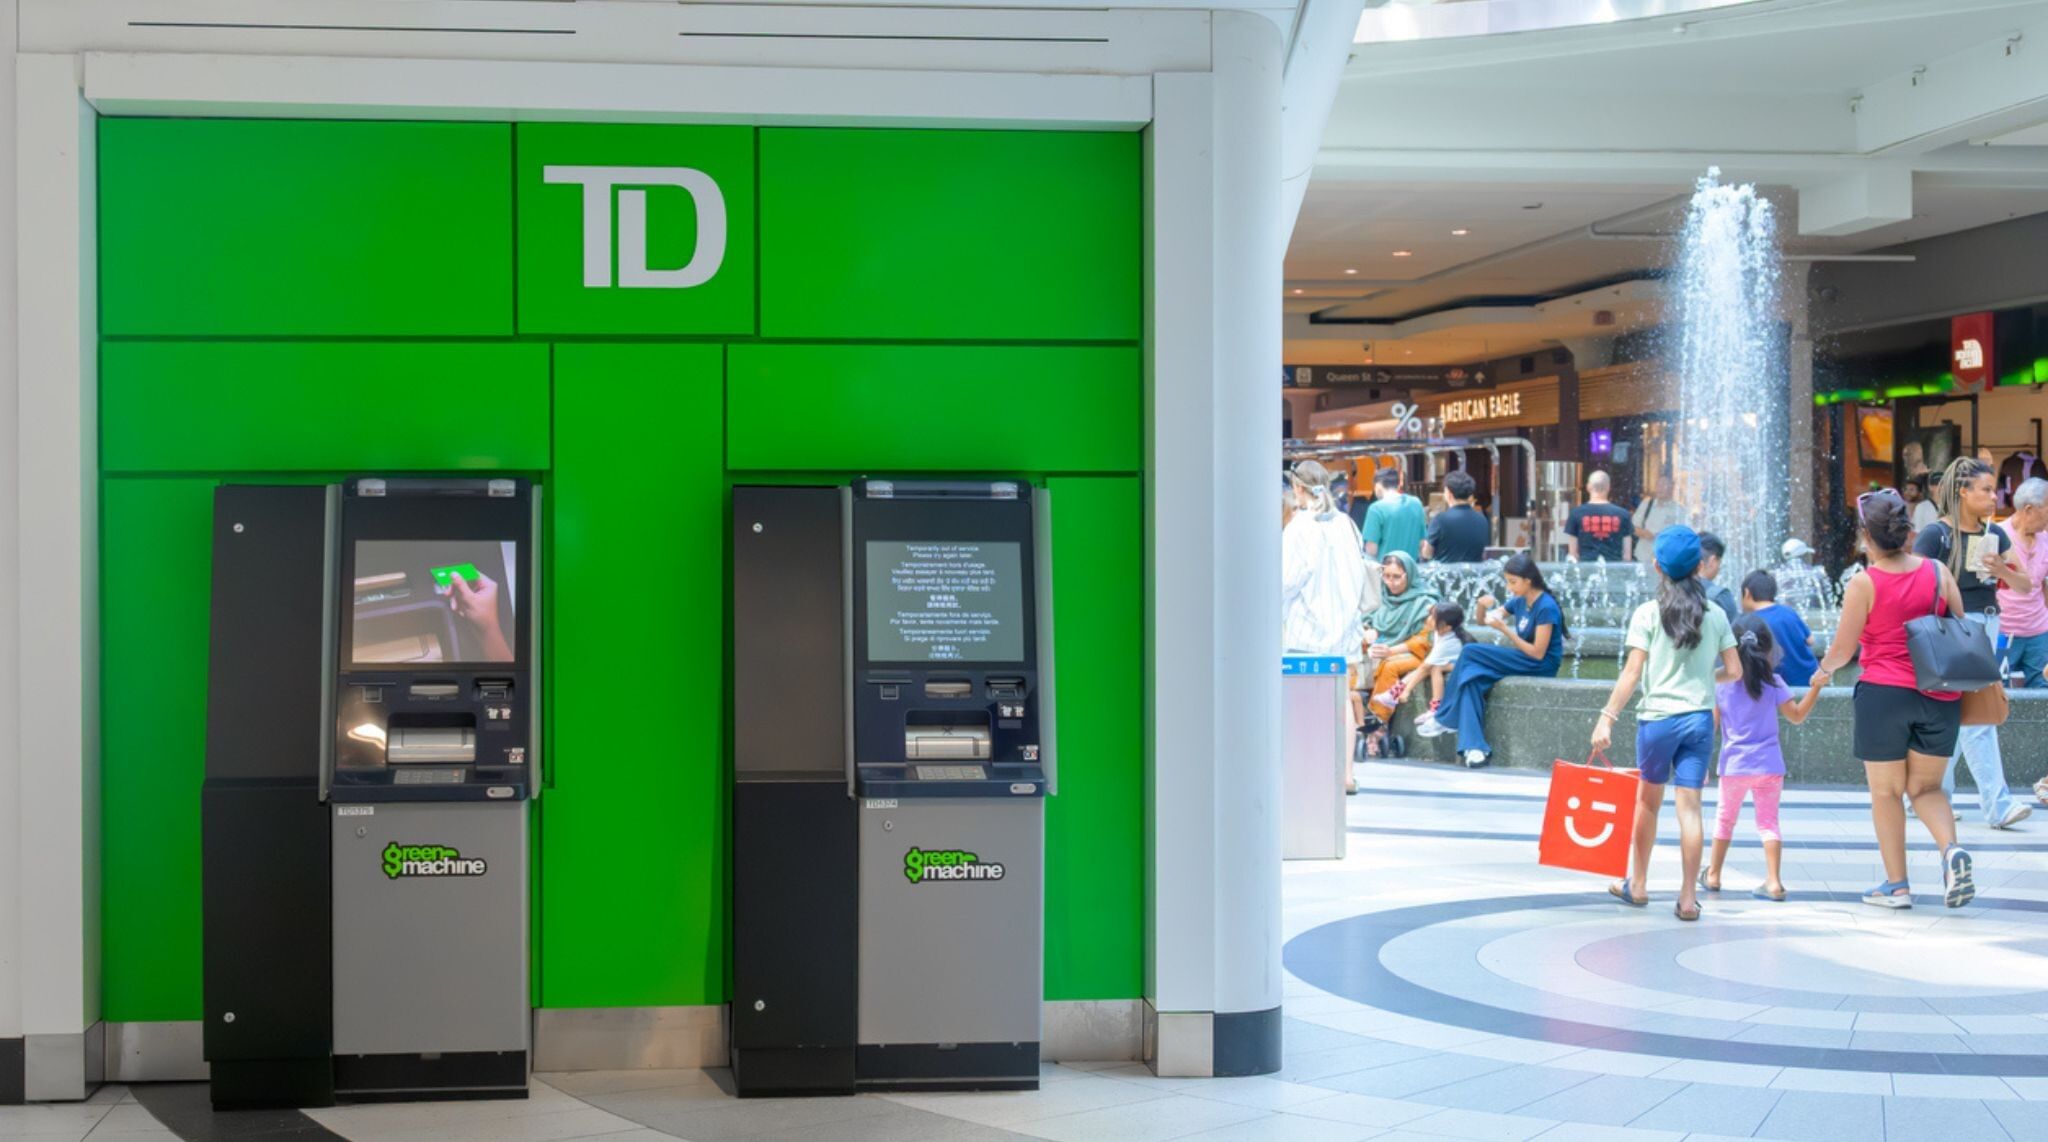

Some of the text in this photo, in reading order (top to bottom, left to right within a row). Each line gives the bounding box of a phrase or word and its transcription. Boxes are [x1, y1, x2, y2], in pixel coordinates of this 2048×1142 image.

[543, 165, 727, 288] TD
[1326, 372, 1360, 382] Queen
[1439, 392, 1520, 422] AMERICAN EAGLE
[402, 857, 486, 876] machine
[923, 862, 1003, 879] machine
